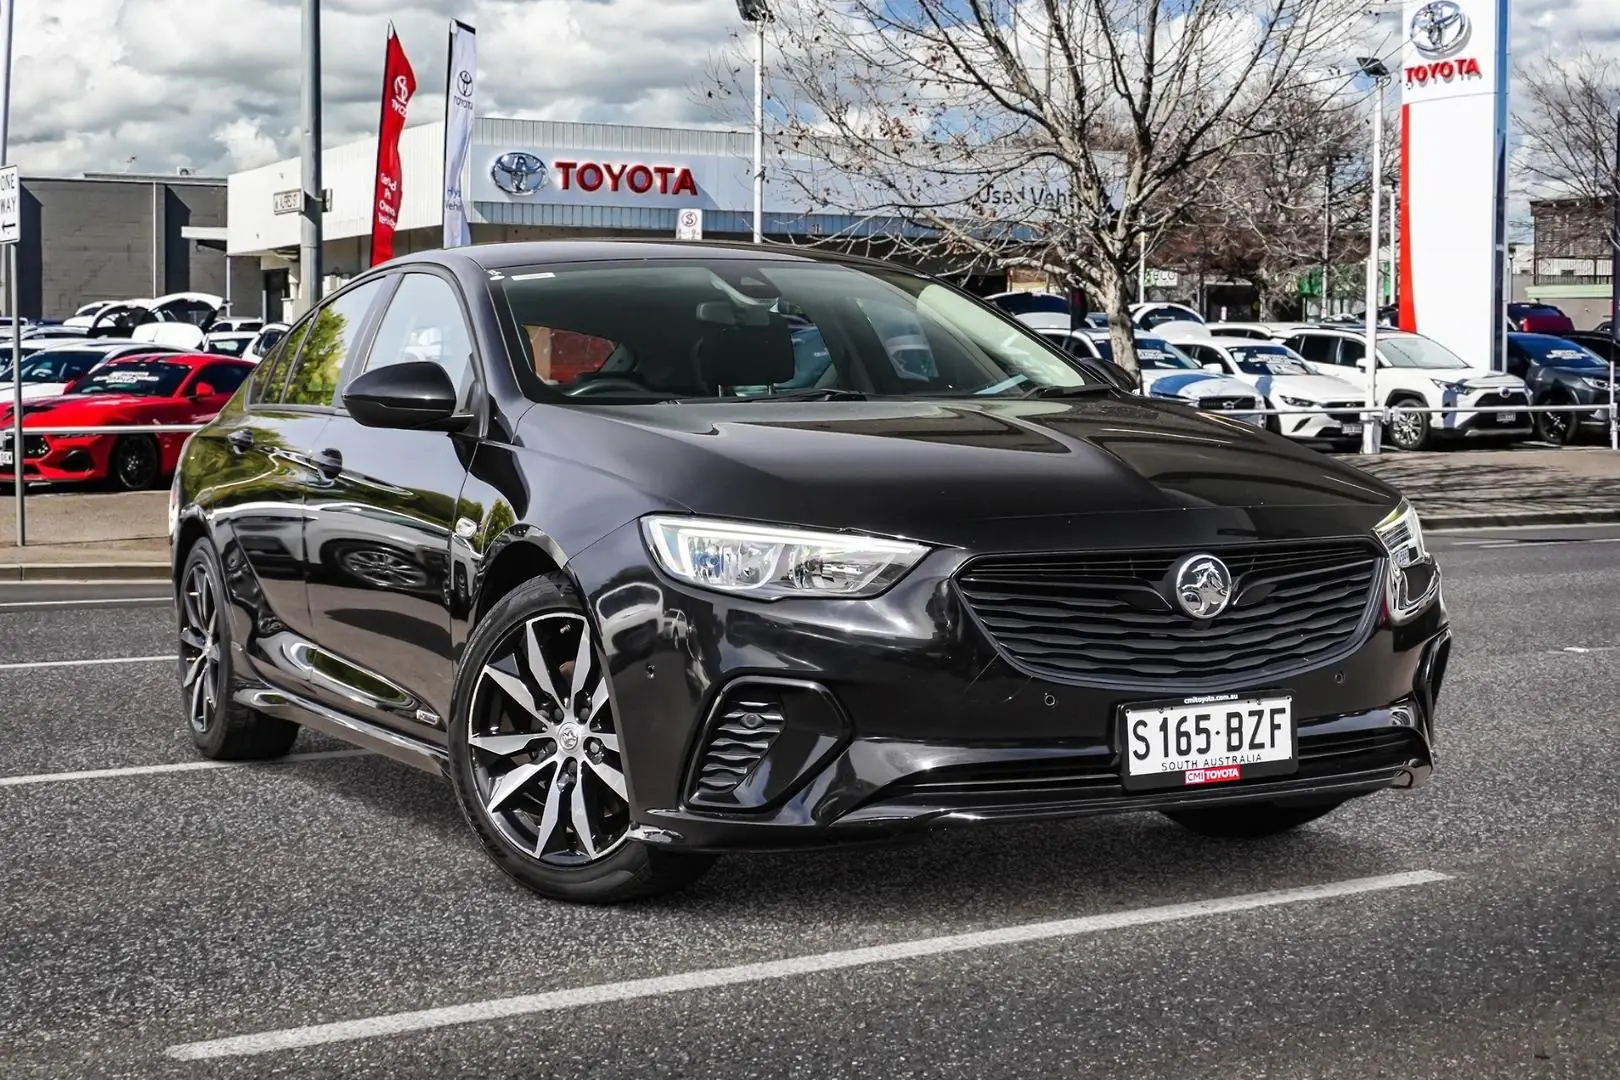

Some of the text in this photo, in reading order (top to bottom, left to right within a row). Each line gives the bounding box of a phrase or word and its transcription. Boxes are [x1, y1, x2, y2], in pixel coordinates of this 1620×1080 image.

[1404, 58, 1482, 82] TOYOTA
[1, 172, 16, 191] ONE
[555, 161, 699, 196] TOYOTA
[1, 196, 16, 213] WAY
[1184, 694, 1238, 704] cmitoyota.com.au
[1161, 753, 1262, 772] SOUTH AUSTRALIA
[1206, 768, 1240, 781] TOYOTA
